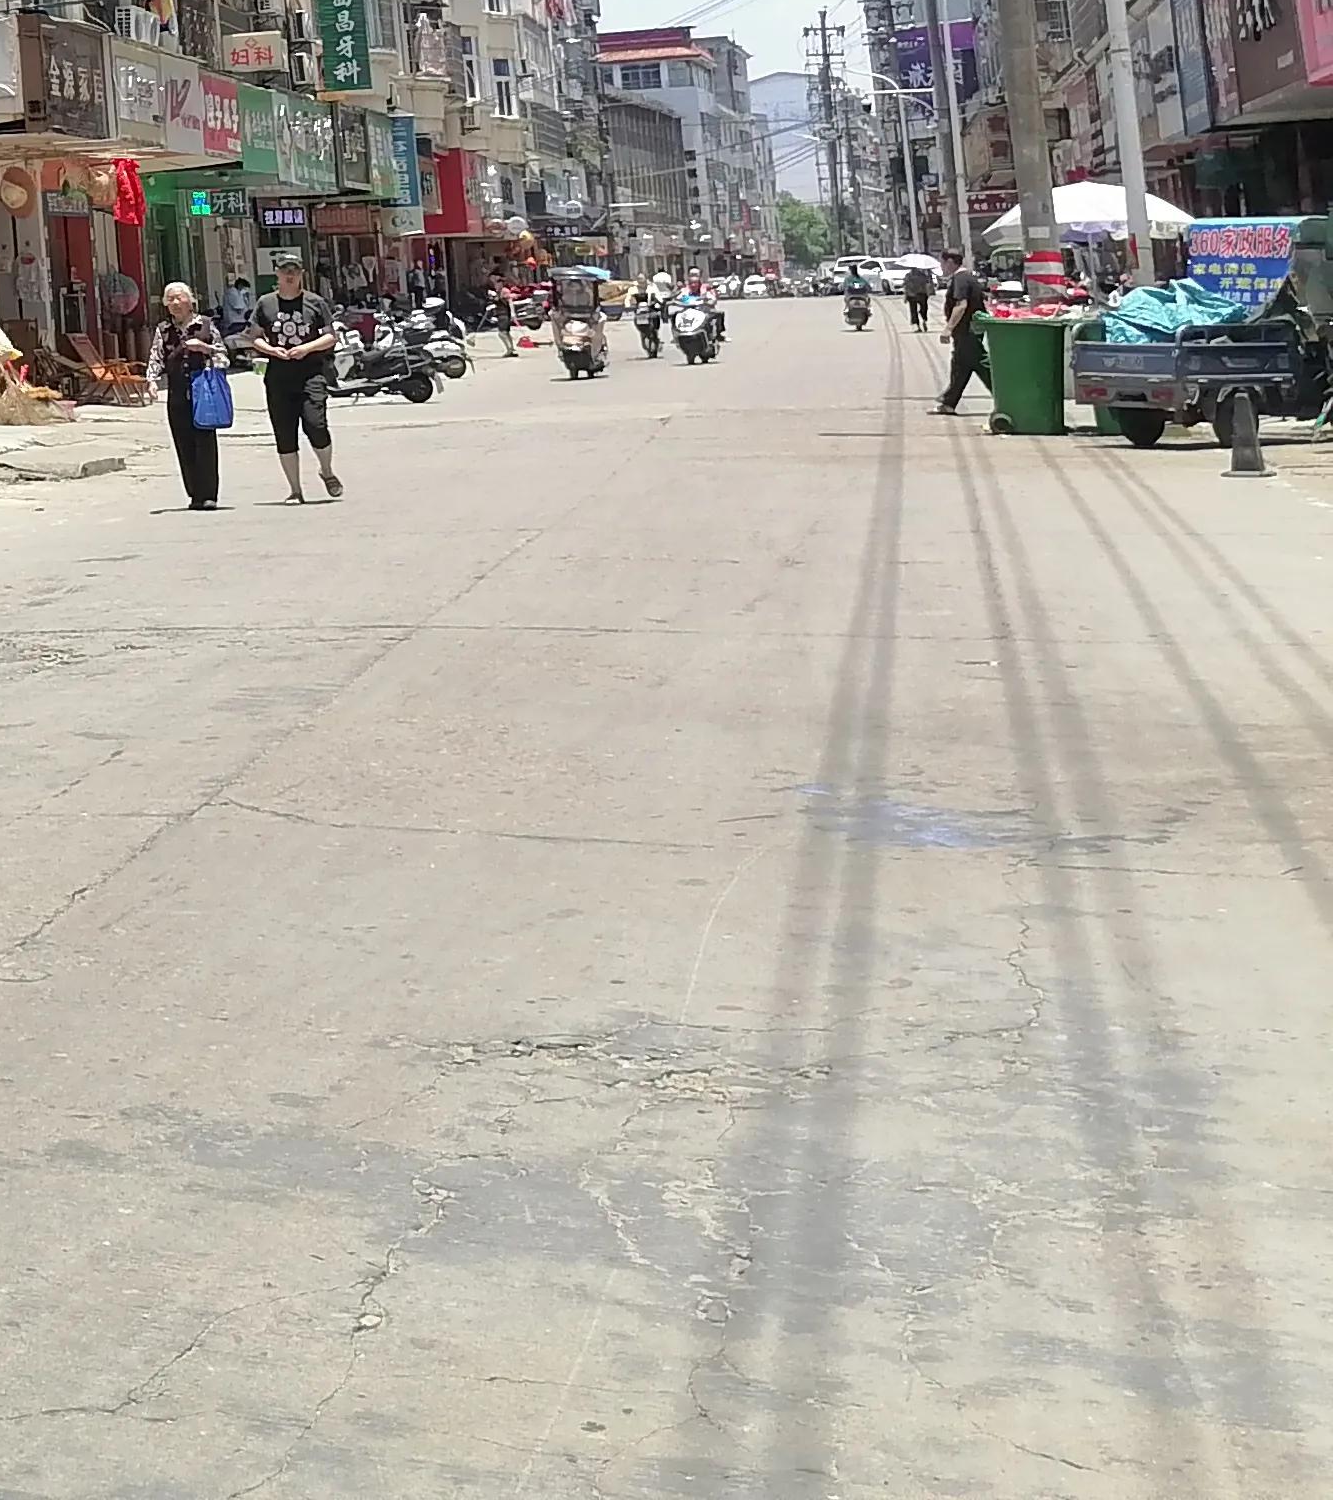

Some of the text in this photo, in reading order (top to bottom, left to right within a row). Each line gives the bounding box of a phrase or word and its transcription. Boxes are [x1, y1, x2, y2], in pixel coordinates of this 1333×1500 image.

[230, 46, 275, 67] 妇科
[213, 190, 244, 213] 牙科
[1189, 223, 1292, 258] 360家政服务
